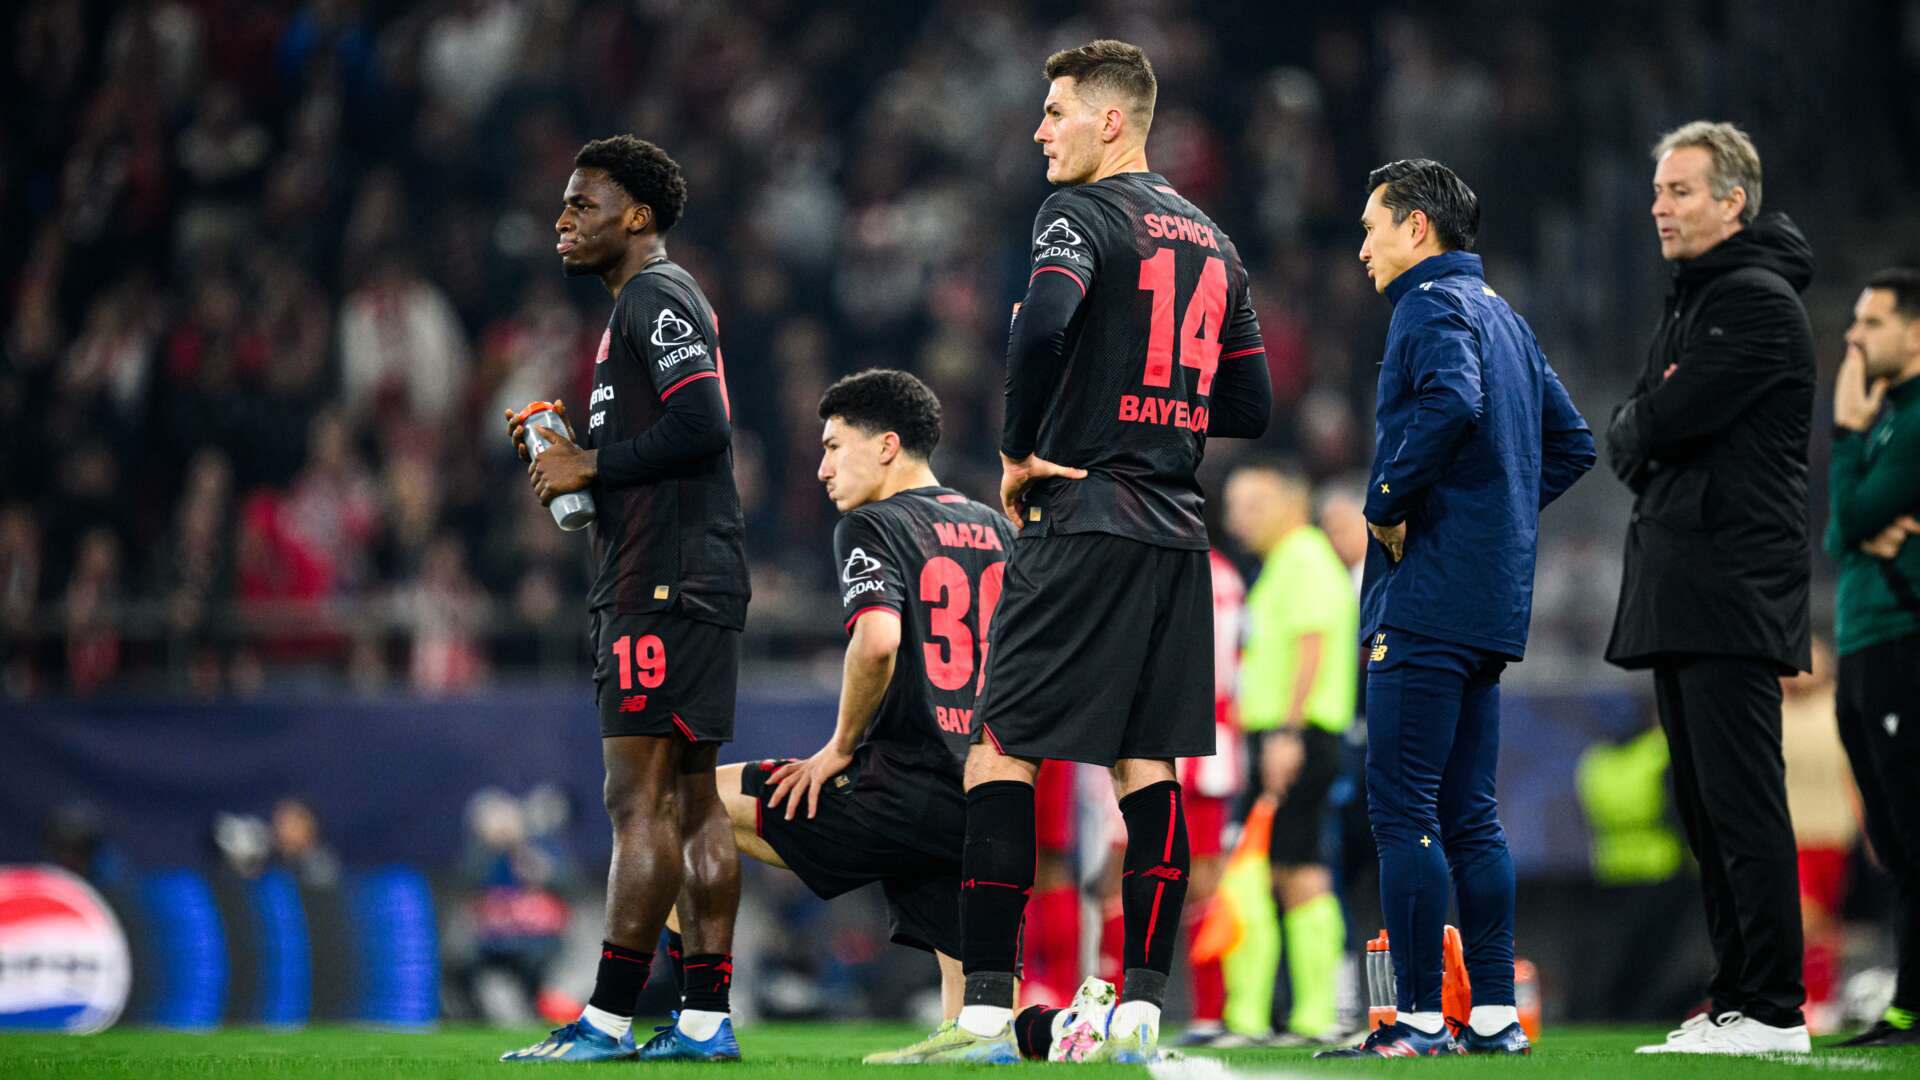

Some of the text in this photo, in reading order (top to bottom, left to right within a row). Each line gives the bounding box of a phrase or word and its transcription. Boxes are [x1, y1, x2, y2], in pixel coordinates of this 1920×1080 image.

[1143, 213, 1220, 252] SCHICK
[1137, 247, 1228, 396] 14
[657, 344, 706, 371] NIEDAX
[1118, 394, 1190, 429] BAYE
[933, 522, 1004, 551] MAZA
[613, 634, 666, 690] 19
